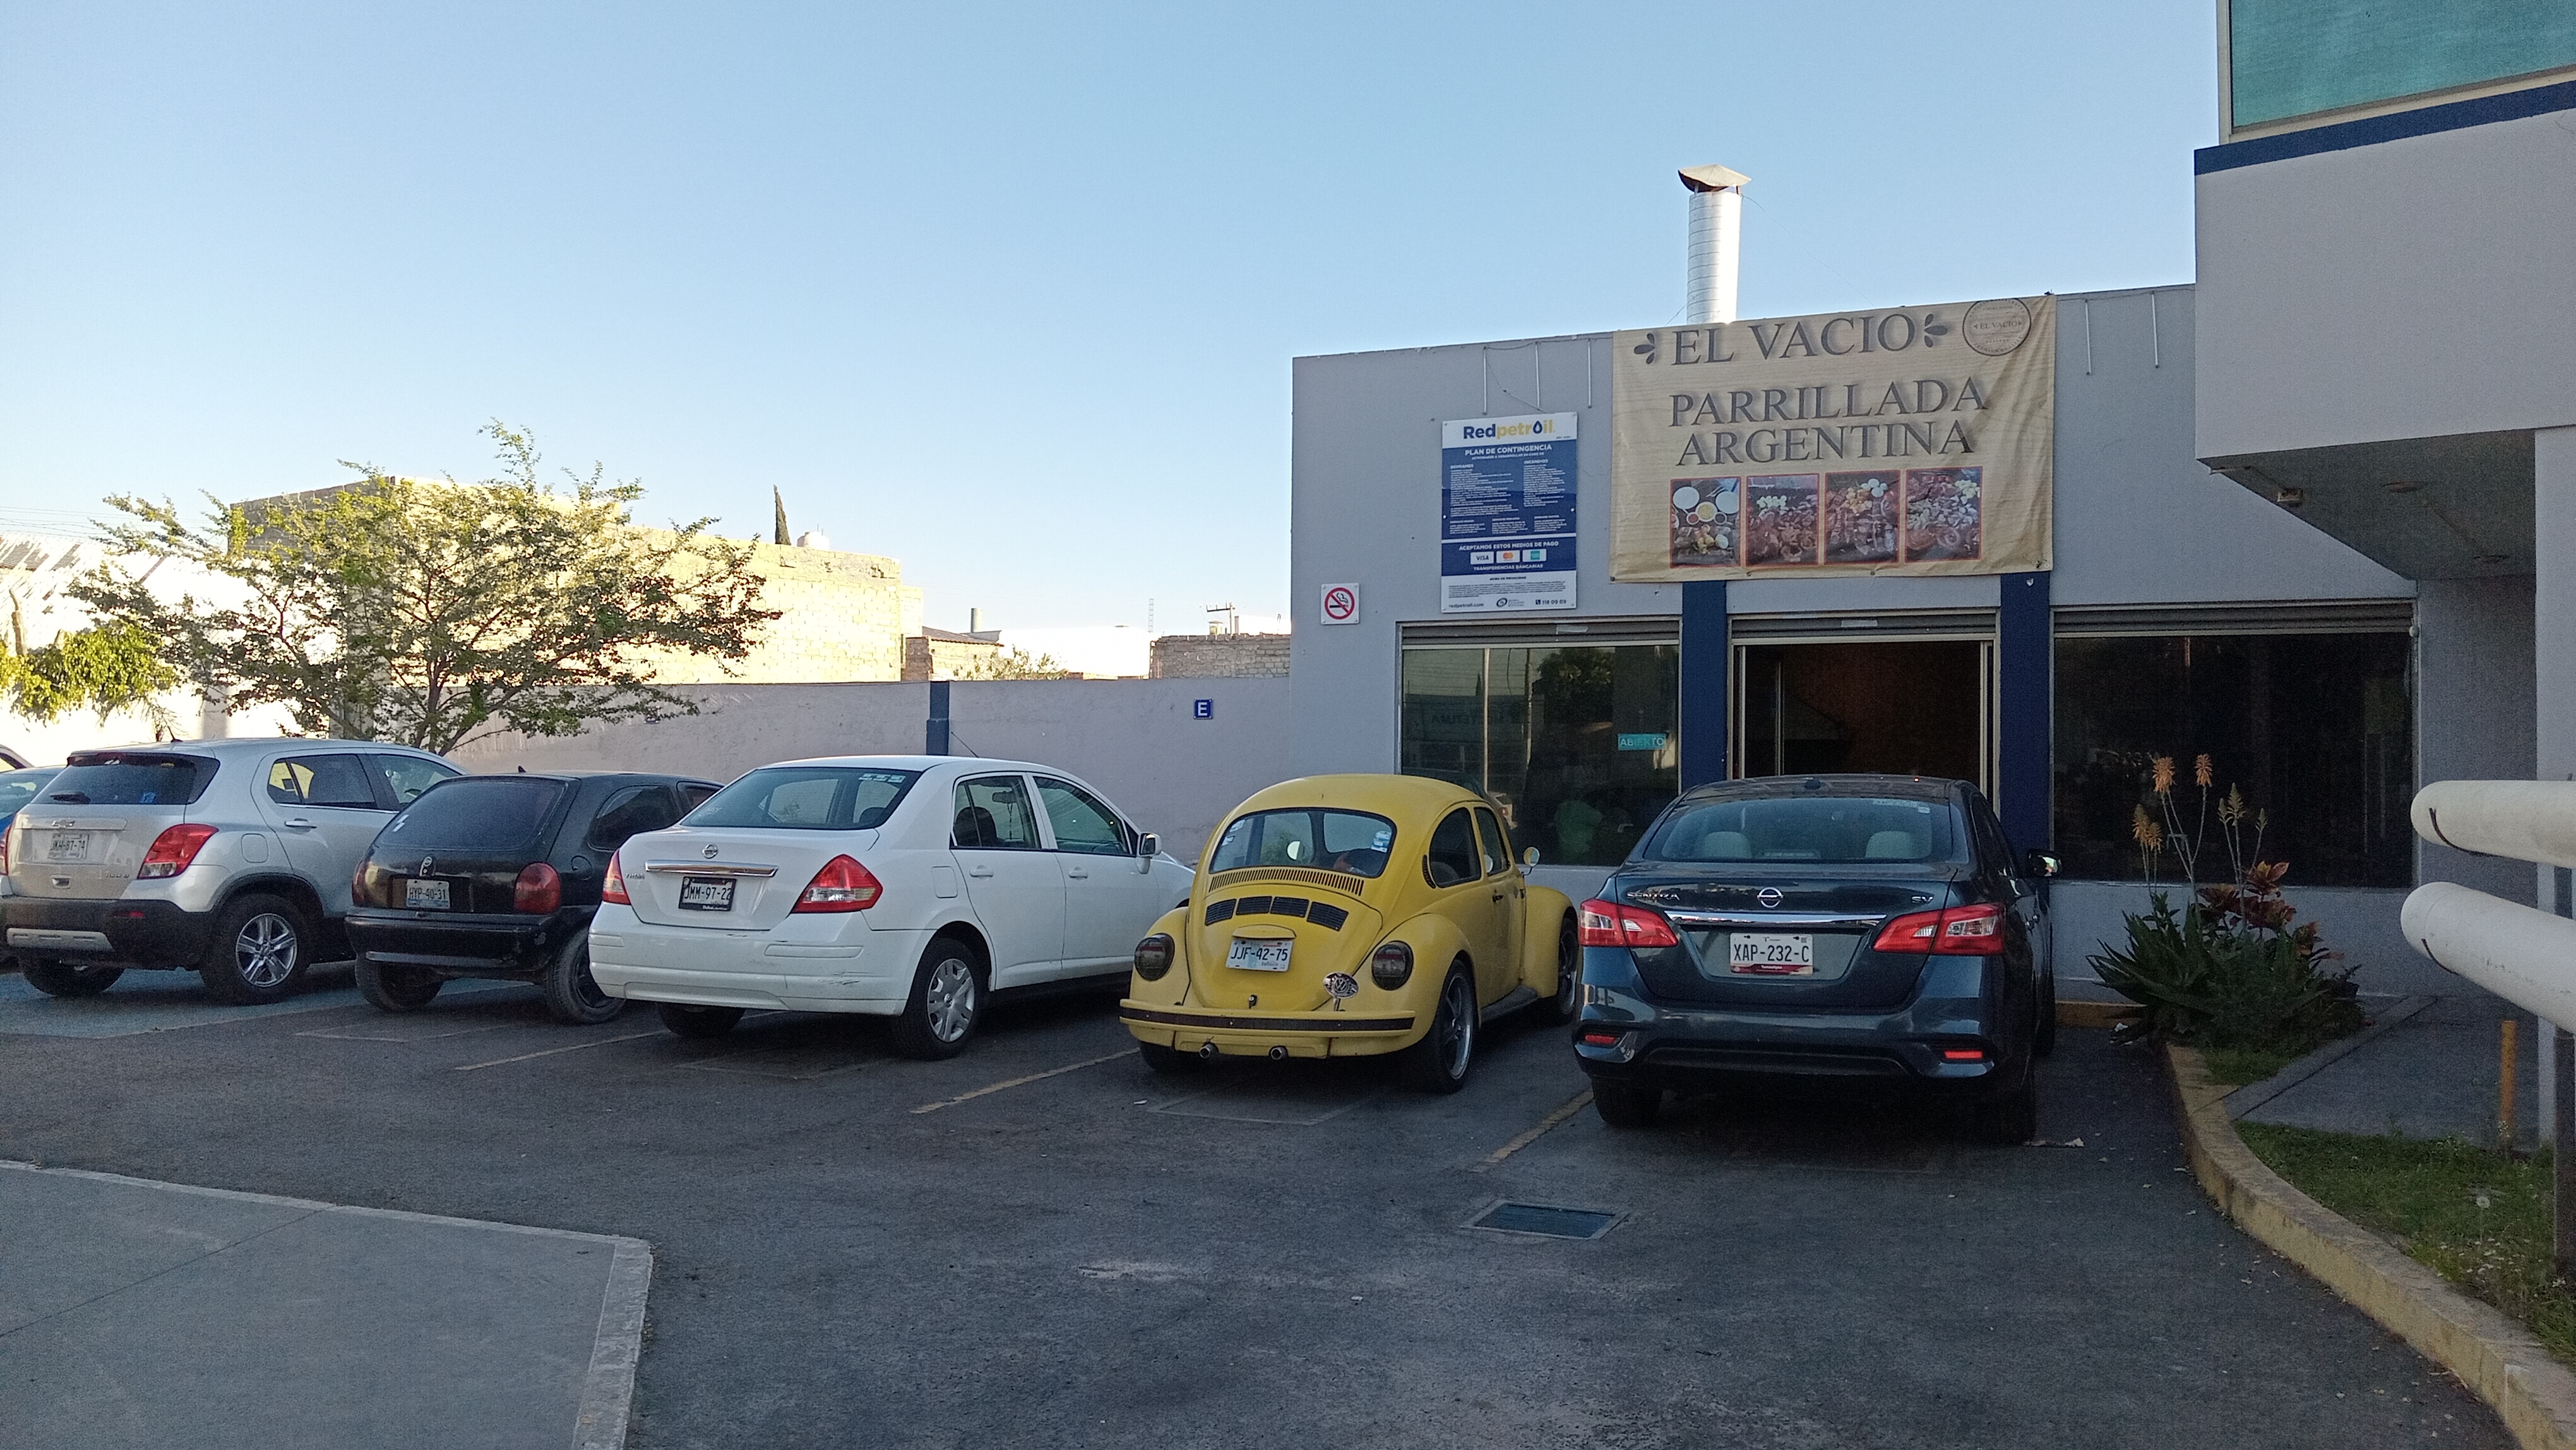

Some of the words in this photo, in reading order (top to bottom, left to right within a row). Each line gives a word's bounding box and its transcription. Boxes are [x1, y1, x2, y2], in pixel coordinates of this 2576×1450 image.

[1992, 320, 2017, 329] VACIO
[1672, 328, 1734, 366] EL
[1748, 313, 1916, 360] VACIO
[1669, 375, 1989, 428] PARRILLADA
[1497, 444, 1552, 453] CONTINGENCIA
[1676, 419, 1976, 467] ARGENTINA
[1198, 702, 1208, 716] E
[1620, 738, 1664, 746] ABIERTO
[684, 885, 731, 901] JMM-97-22
[1231, 947, 1288, 961] JJF-42-75
[1734, 944, 1809, 962] XAP-232-C
